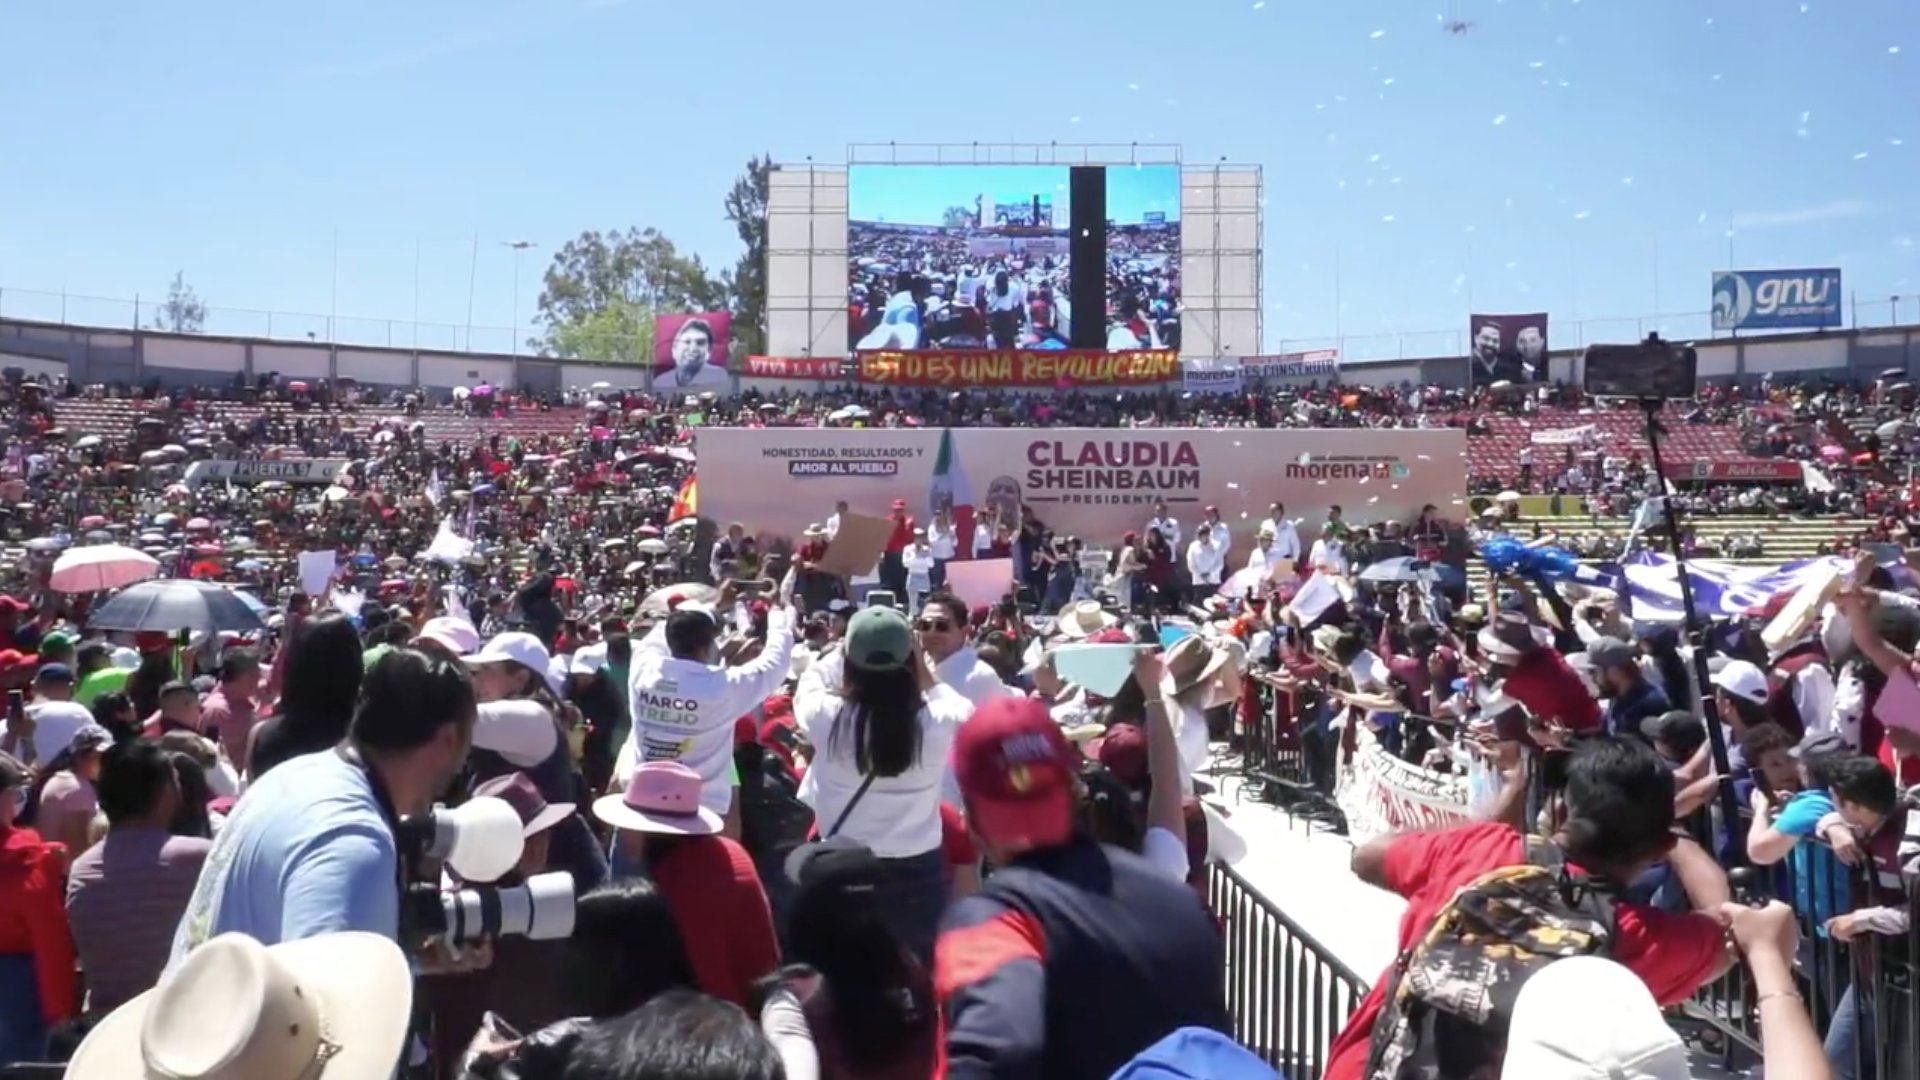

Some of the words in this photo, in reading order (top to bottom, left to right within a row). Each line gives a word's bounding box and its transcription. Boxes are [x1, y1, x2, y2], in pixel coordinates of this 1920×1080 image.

[1755, 277, 1830, 315] gnu
[749, 359, 787, 375] VIVA
[793, 362, 812, 376] LA
[926, 355, 956, 384] ES
[960, 353, 1012, 381] UNA
[1186, 370, 1235, 381] morena
[1263, 359, 1335, 378] CONSTRUIR
[762, 447, 838, 459] HONESTIDAD,
[841, 447, 913, 459] RESULTADOS
[913, 447, 924, 458] Y
[1027, 440, 1199, 467] CLAUDIA
[239, 461, 296, 476] PUERTA
[300, 461, 309, 475] 9
[792, 462, 828, 473] AMOR
[830, 462, 846, 473] AL
[848, 462, 896, 473] PUEBLO
[1285, 462, 1370, 479] morena
[1027, 469, 1199, 490] SHEINBAUM
[1061, 494, 1164, 504] PRESIDENTA
[640, 690, 698, 711] MARCO
[640, 704, 698, 725] TREJO
